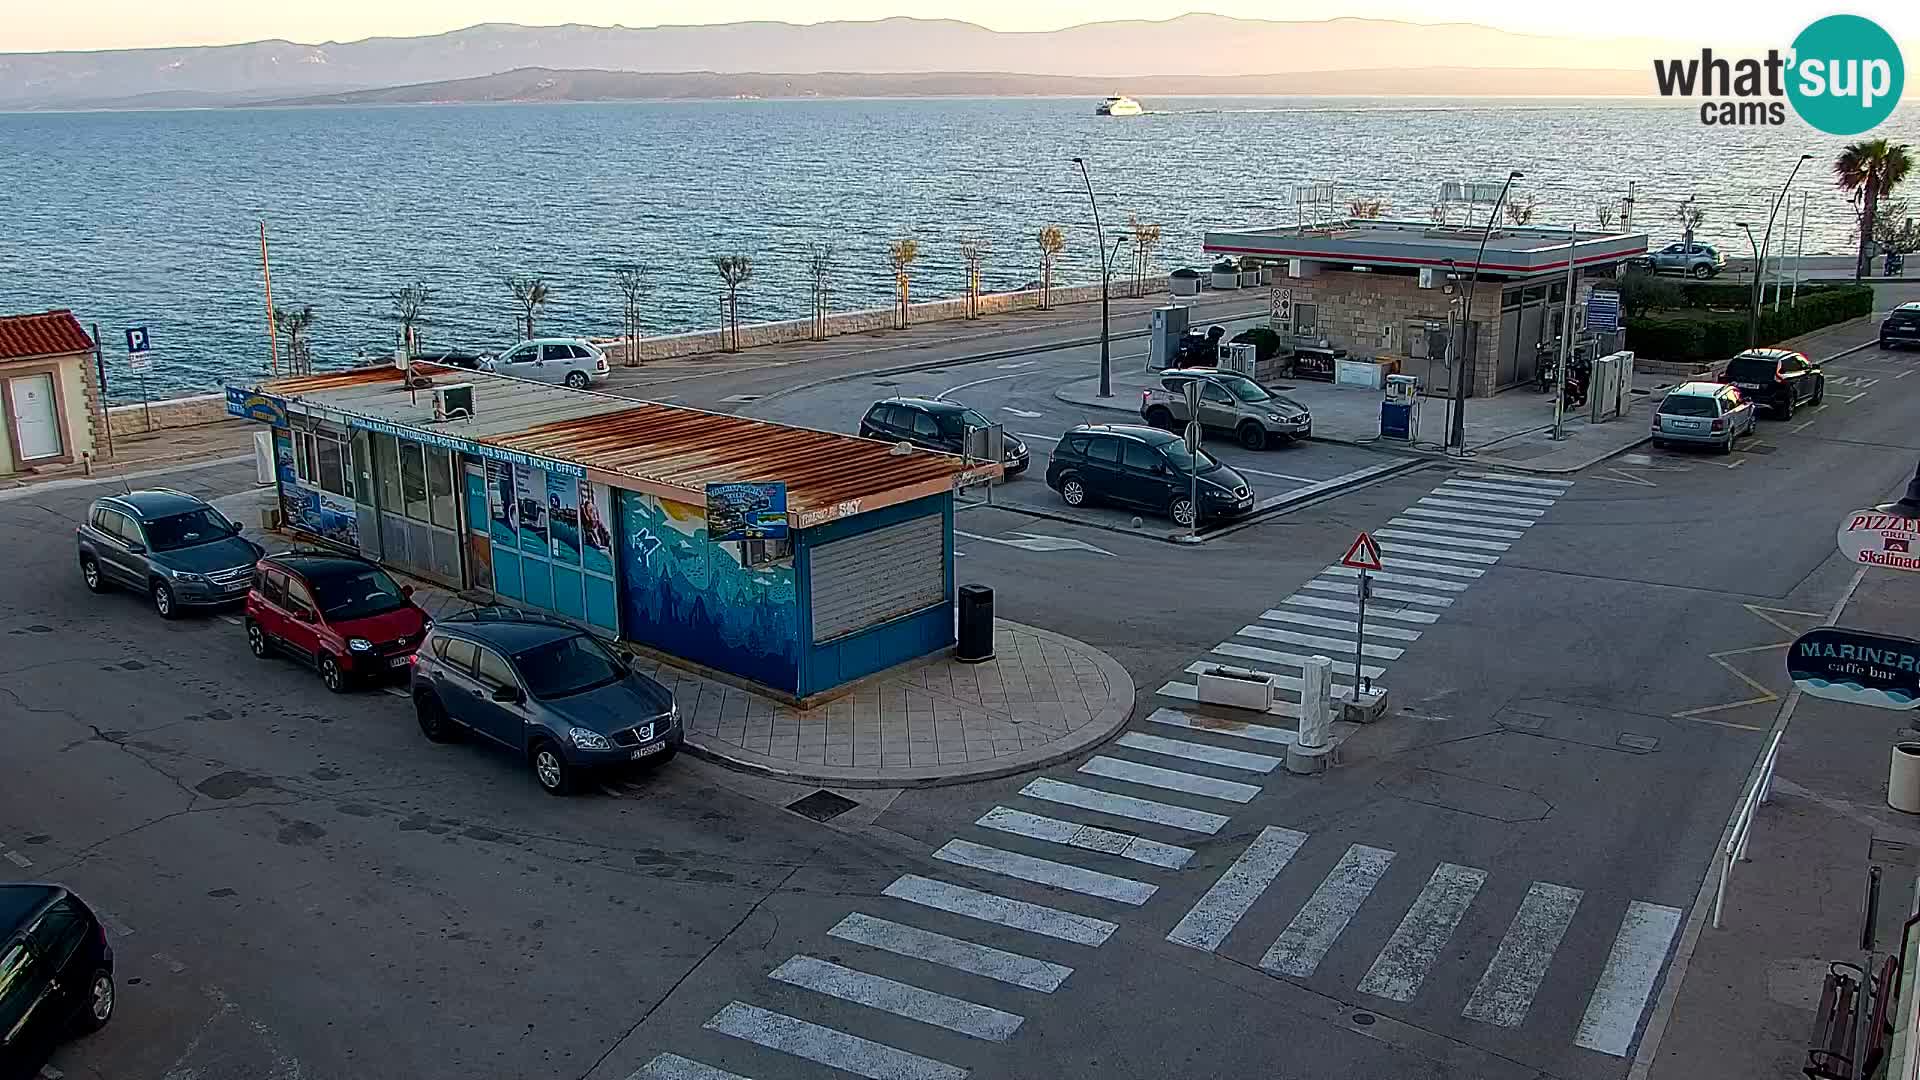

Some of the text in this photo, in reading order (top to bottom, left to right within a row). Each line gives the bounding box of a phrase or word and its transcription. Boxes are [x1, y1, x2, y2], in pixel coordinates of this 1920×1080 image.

[131, 331, 143, 349] P
[397, 427, 436, 443] AUTOBUSNA
[437, 435, 469, 451] POSTAJA
[478, 445, 493, 457] BUS
[495, 449, 527, 465] STATION
[528, 456, 555, 472] TICKET
[556, 463, 583, 477] OFFICE
[1881, 530, 1917, 541] GRILL
[1828, 663, 1896, 680] caffe bar
